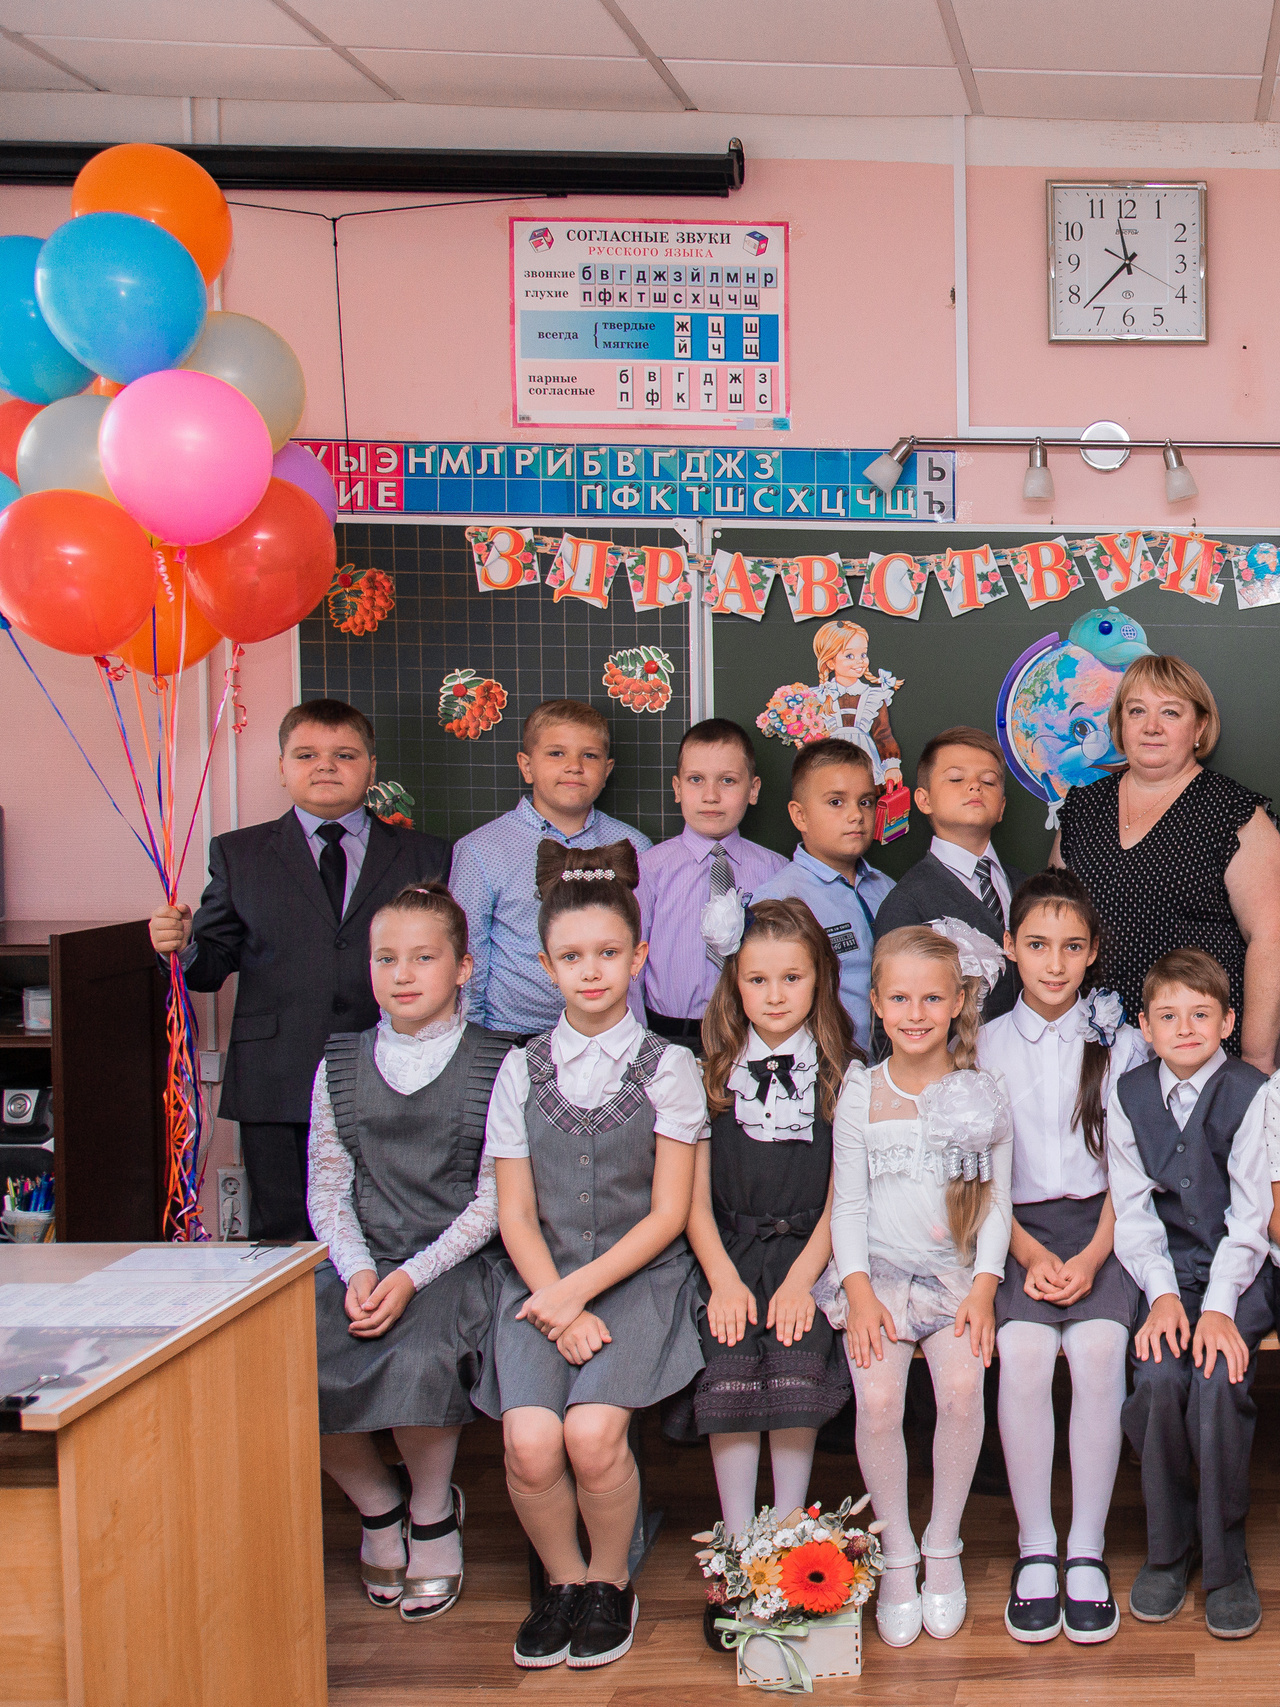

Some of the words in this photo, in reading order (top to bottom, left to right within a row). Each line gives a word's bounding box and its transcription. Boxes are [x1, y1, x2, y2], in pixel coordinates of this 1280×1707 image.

[1089, 199, 1104, 218] 11
[1117, 199, 1137, 218] 12
[1155, 200, 1161, 219] 1
[566, 230, 669, 244] СОГЛАСНЫЕ
[676, 232, 731, 244] ЗВУКИ
[1065, 222, 1083, 241] 10
[1174, 223, 1187, 242] 2
[588, 246, 658, 257] РУССКОГО
[664, 248, 713, 258] ЯЗЫКА
[1068, 254, 1080, 273] 9
[1175, 254, 1187, 274] 3
[524, 270, 575, 279] звонкие
[582, 266, 592, 280] б
[600, 270, 609, 280] в
[619, 270, 626, 280] г
[636, 270, 646, 283] д
[653, 270, 666, 281] ж
[673, 271, 682, 282] з
[691, 266, 700, 282] й
[709, 272, 719, 282] л
[727, 272, 738, 282] м
[746, 272, 755, 283] н
[764, 272, 773, 286] р
[525, 290, 569, 300] глухие
[583, 291, 591, 302] п
[598, 288, 612, 305] ф
[619, 292, 627, 302] к
[637, 292, 646, 302] т
[654, 292, 666, 303] ш
[674, 292, 682, 303] с
[692, 292, 700, 303] х
[710, 293, 719, 306] ц
[728, 293, 736, 304] ч
[744, 294, 758, 307] щ
[1069, 285, 1080, 304] 8
[1175, 285, 1187, 304] 4
[1093, 307, 1105, 326] 7
[1123, 308, 1134, 326] 6
[1153, 308, 1164, 326] 5
[538, 331, 578, 340] всегда
[602, 321, 656, 332] твердые
[603, 340, 649, 350] мягкие
[528, 374, 577, 385] парные
[528, 386, 595, 396] согласные
[339, 446, 366, 472] Ы
[376, 446, 398, 473] Э
[409, 447, 431, 474] Н
[440, 448, 471, 475] М
[477, 449, 500, 475] Л
[516, 450, 535, 475] Р
[547, 447, 572, 476] Й
[583, 450, 602, 476] Б
[617, 451, 637, 477] В
[653, 452, 672, 477] Г
[681, 452, 708, 480] Д
[714, 453, 745, 479] Ж
[754, 453, 774, 480] З
[928, 457, 946, 481] Ь
[339, 481, 363, 507] И
[378, 482, 396, 507] Е
[582, 484, 603, 509] П
[611, 486, 640, 511] Ф
[649, 486, 672, 511] К
[686, 487, 705, 511] Т
[714, 487, 744, 512] Ш
[753, 487, 774, 513] С
[786, 488, 810, 513] Х
[821, 489, 846, 516] Ц
[856, 489, 876, 514] Ч
[885, 490, 917, 517] Щ
[924, 491, 945, 514] Ъ
